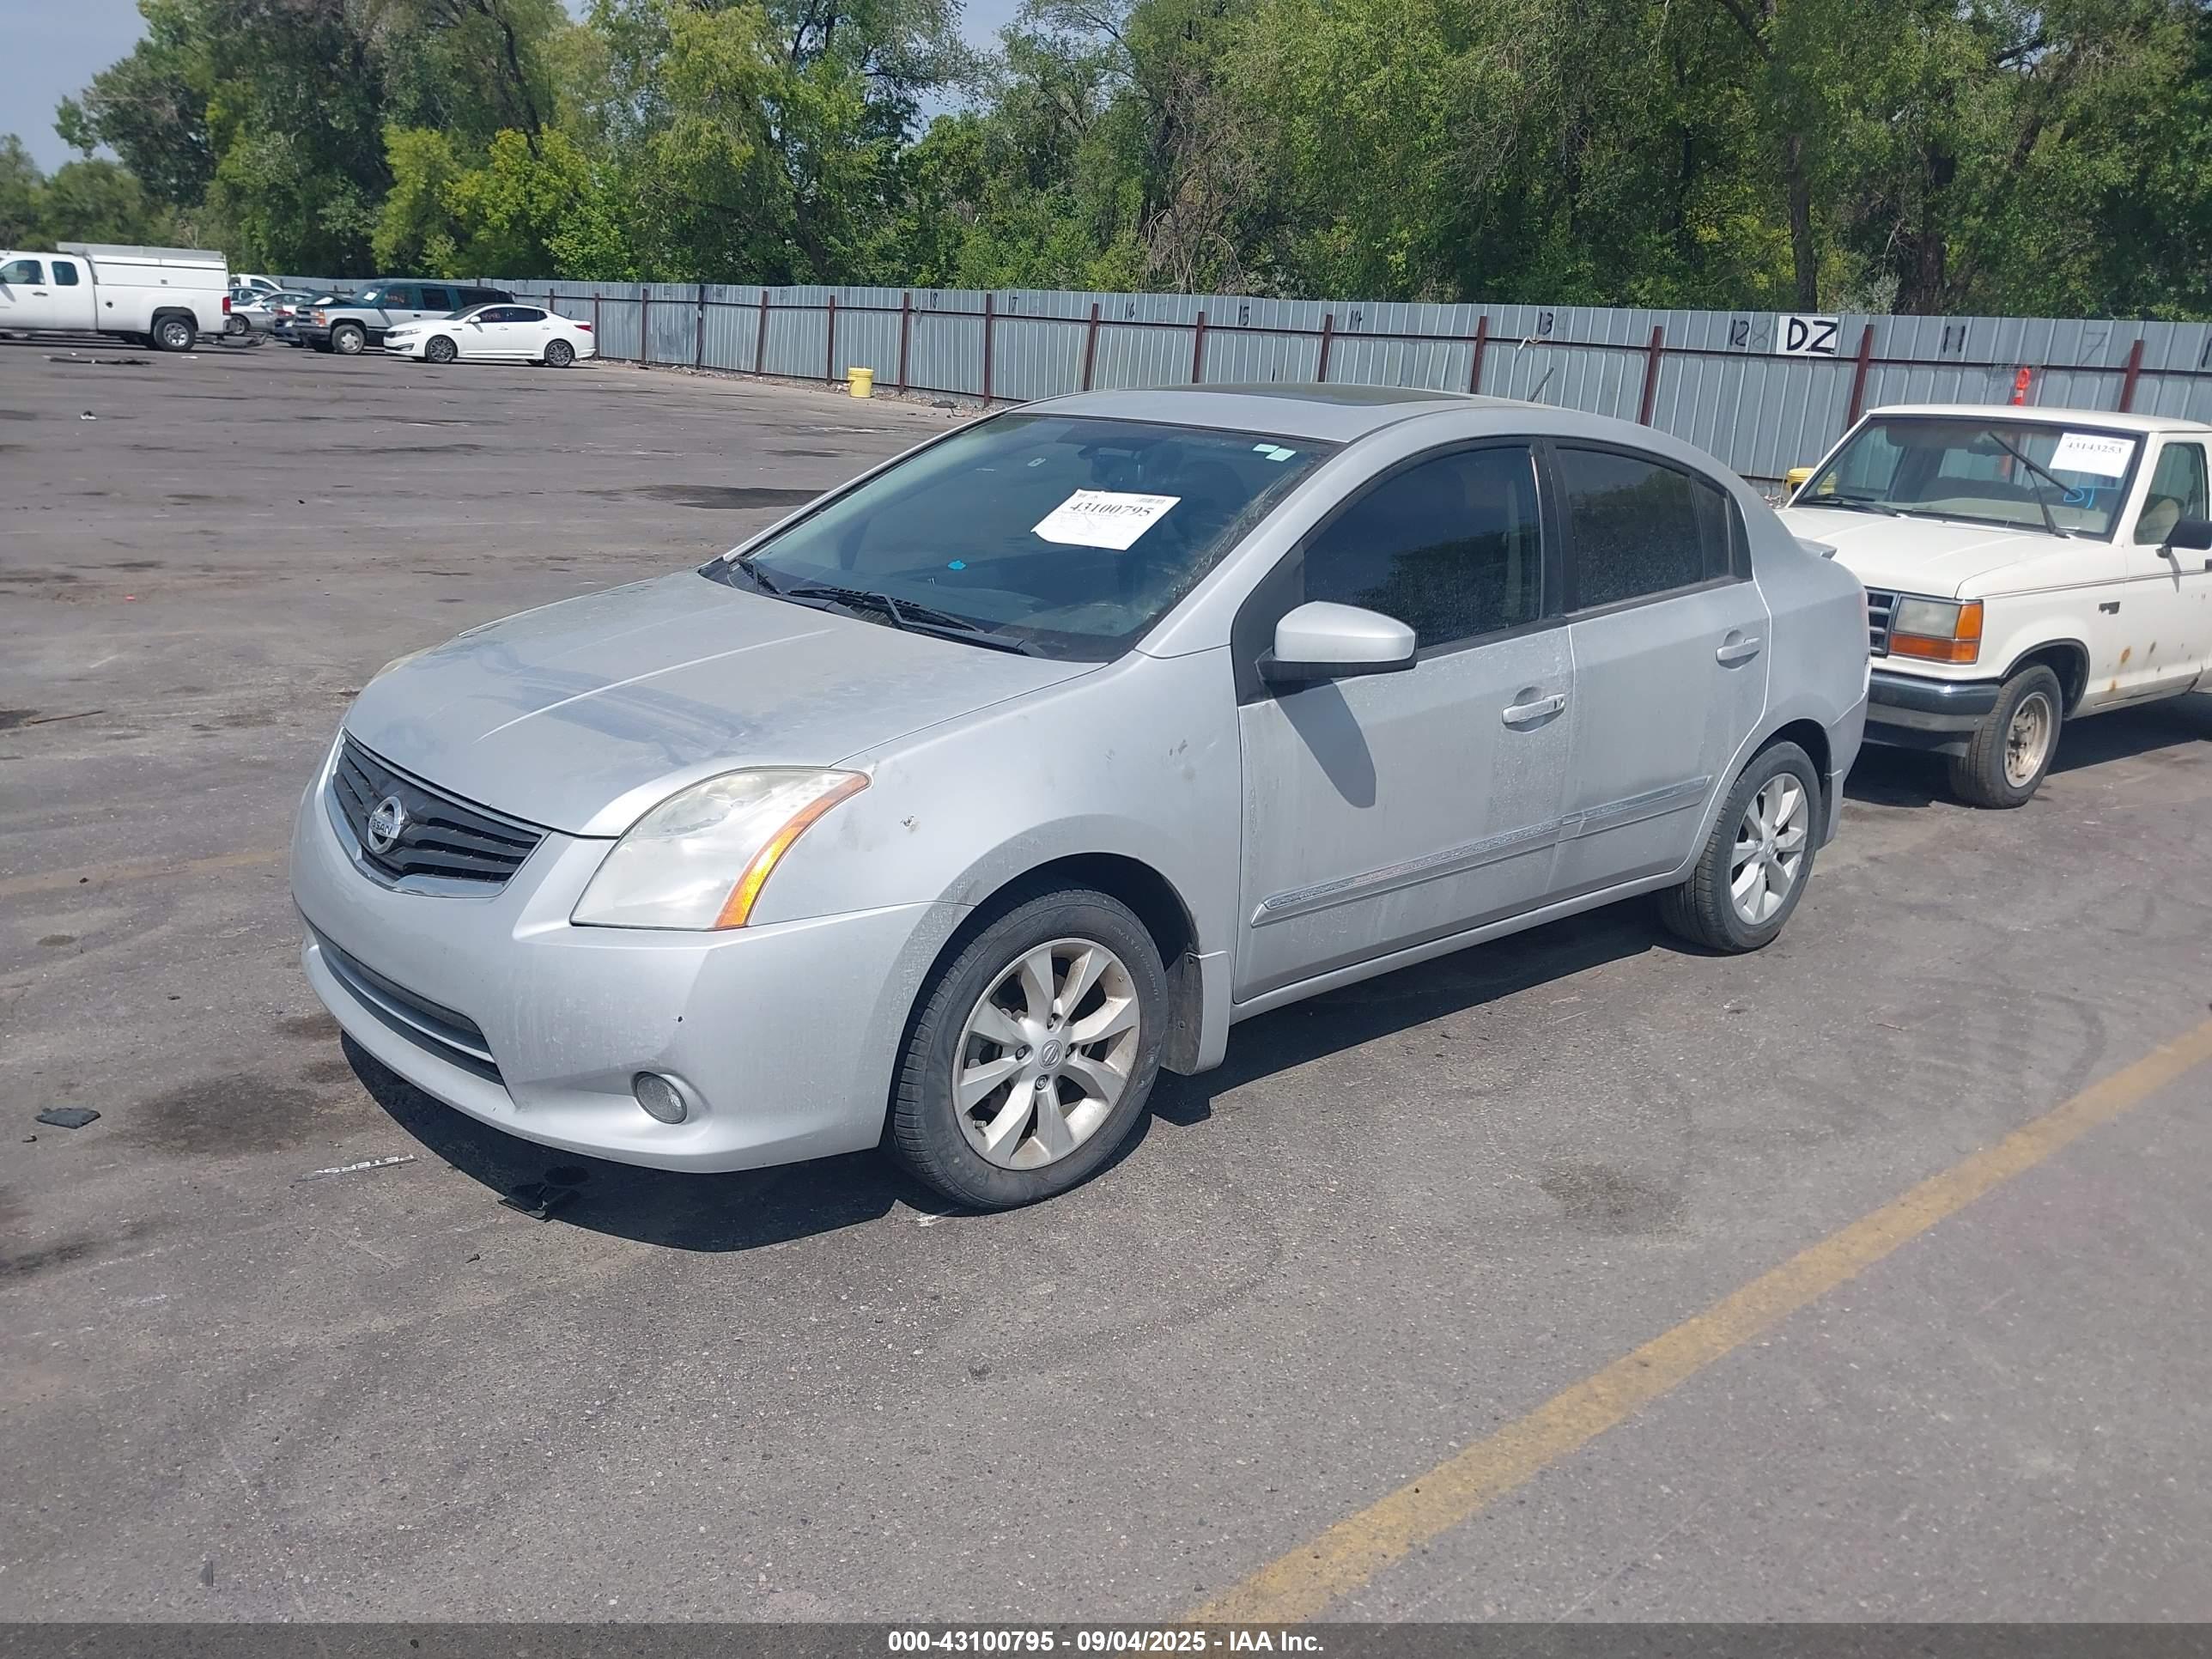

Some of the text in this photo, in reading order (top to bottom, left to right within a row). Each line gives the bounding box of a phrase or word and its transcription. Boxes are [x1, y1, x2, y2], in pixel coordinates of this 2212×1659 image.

[1007, 295, 1018, 314] 17
[1124, 301, 1135, 320] 16
[1237, 304, 1250, 326] 15
[1348, 309, 1363, 331] 14
[1537, 311, 1554, 336] 13
[1729, 319, 1750, 347] 12
[1786, 317, 1838, 355] DZ
[1070, 501, 1155, 517] 43100795
